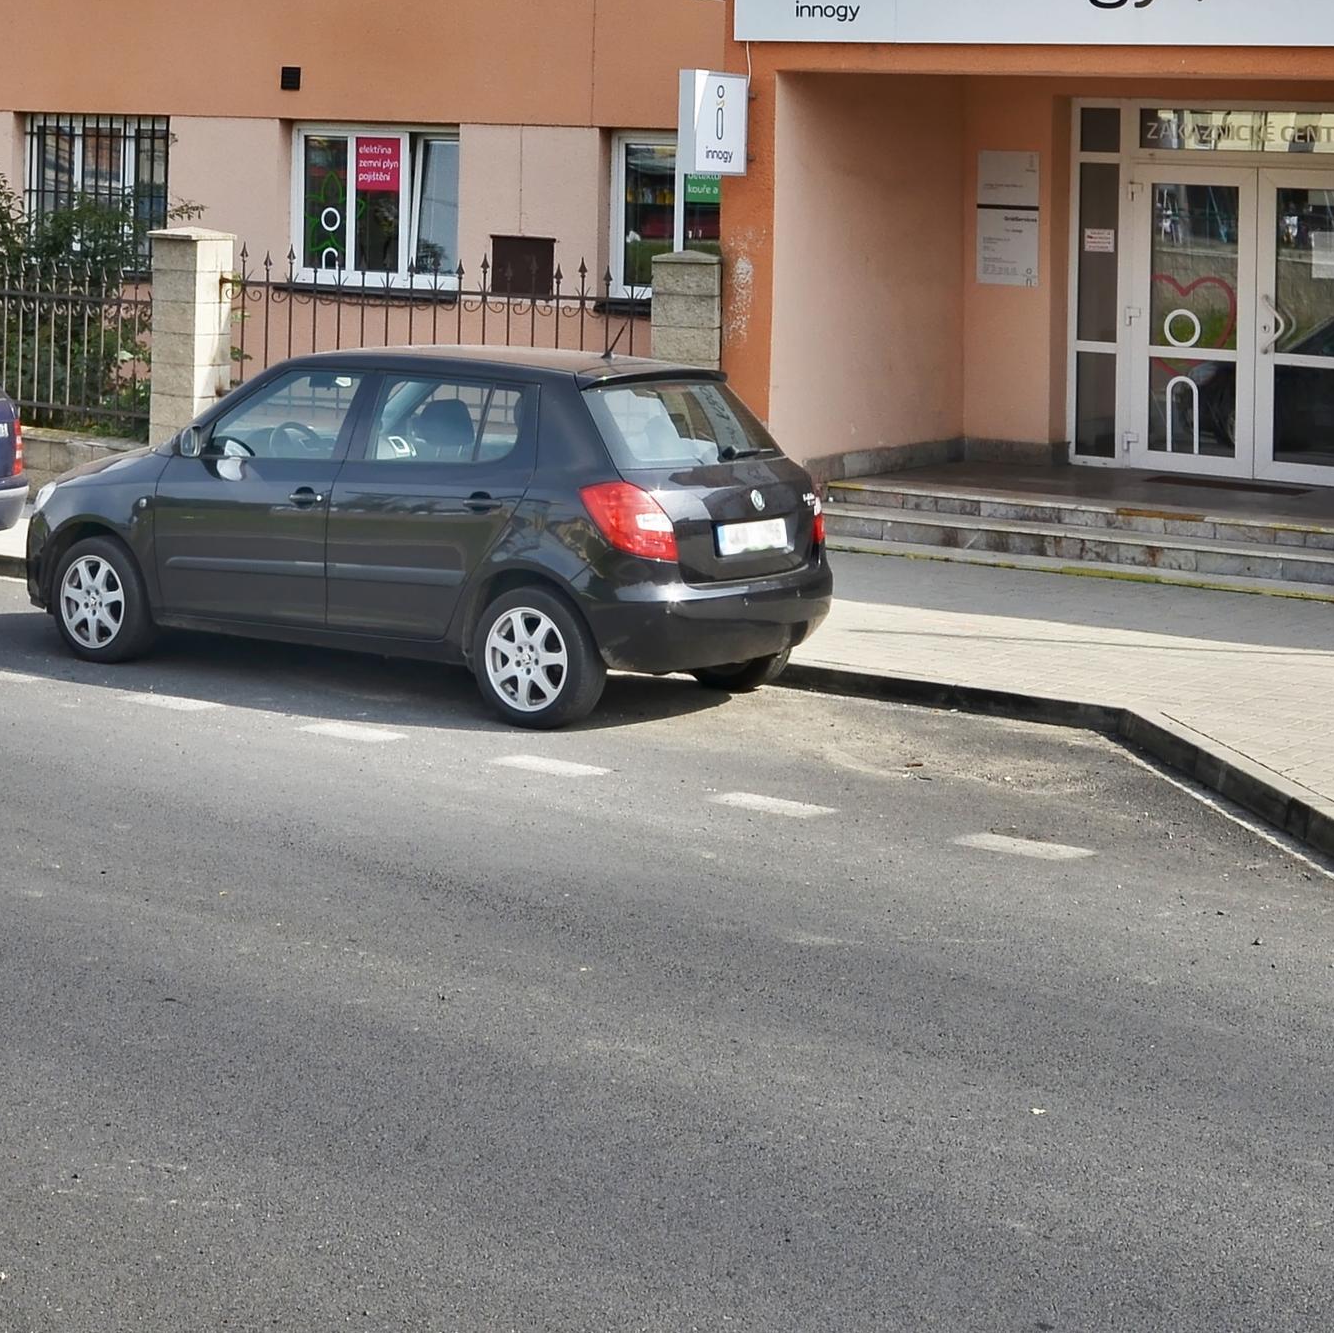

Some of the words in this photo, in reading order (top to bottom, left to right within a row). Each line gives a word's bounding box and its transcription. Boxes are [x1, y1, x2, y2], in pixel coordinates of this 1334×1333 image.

[795, 1, 860, 22] innogy
[1146, 120, 1276, 143] ZÁKAZNICKÉ
[358, 144, 392, 154] elektřina
[705, 146, 733, 163] innogy
[358, 159, 382, 167] zemní
[383, 159, 399, 170] plyn
[358, 172, 391, 183] pojištění
